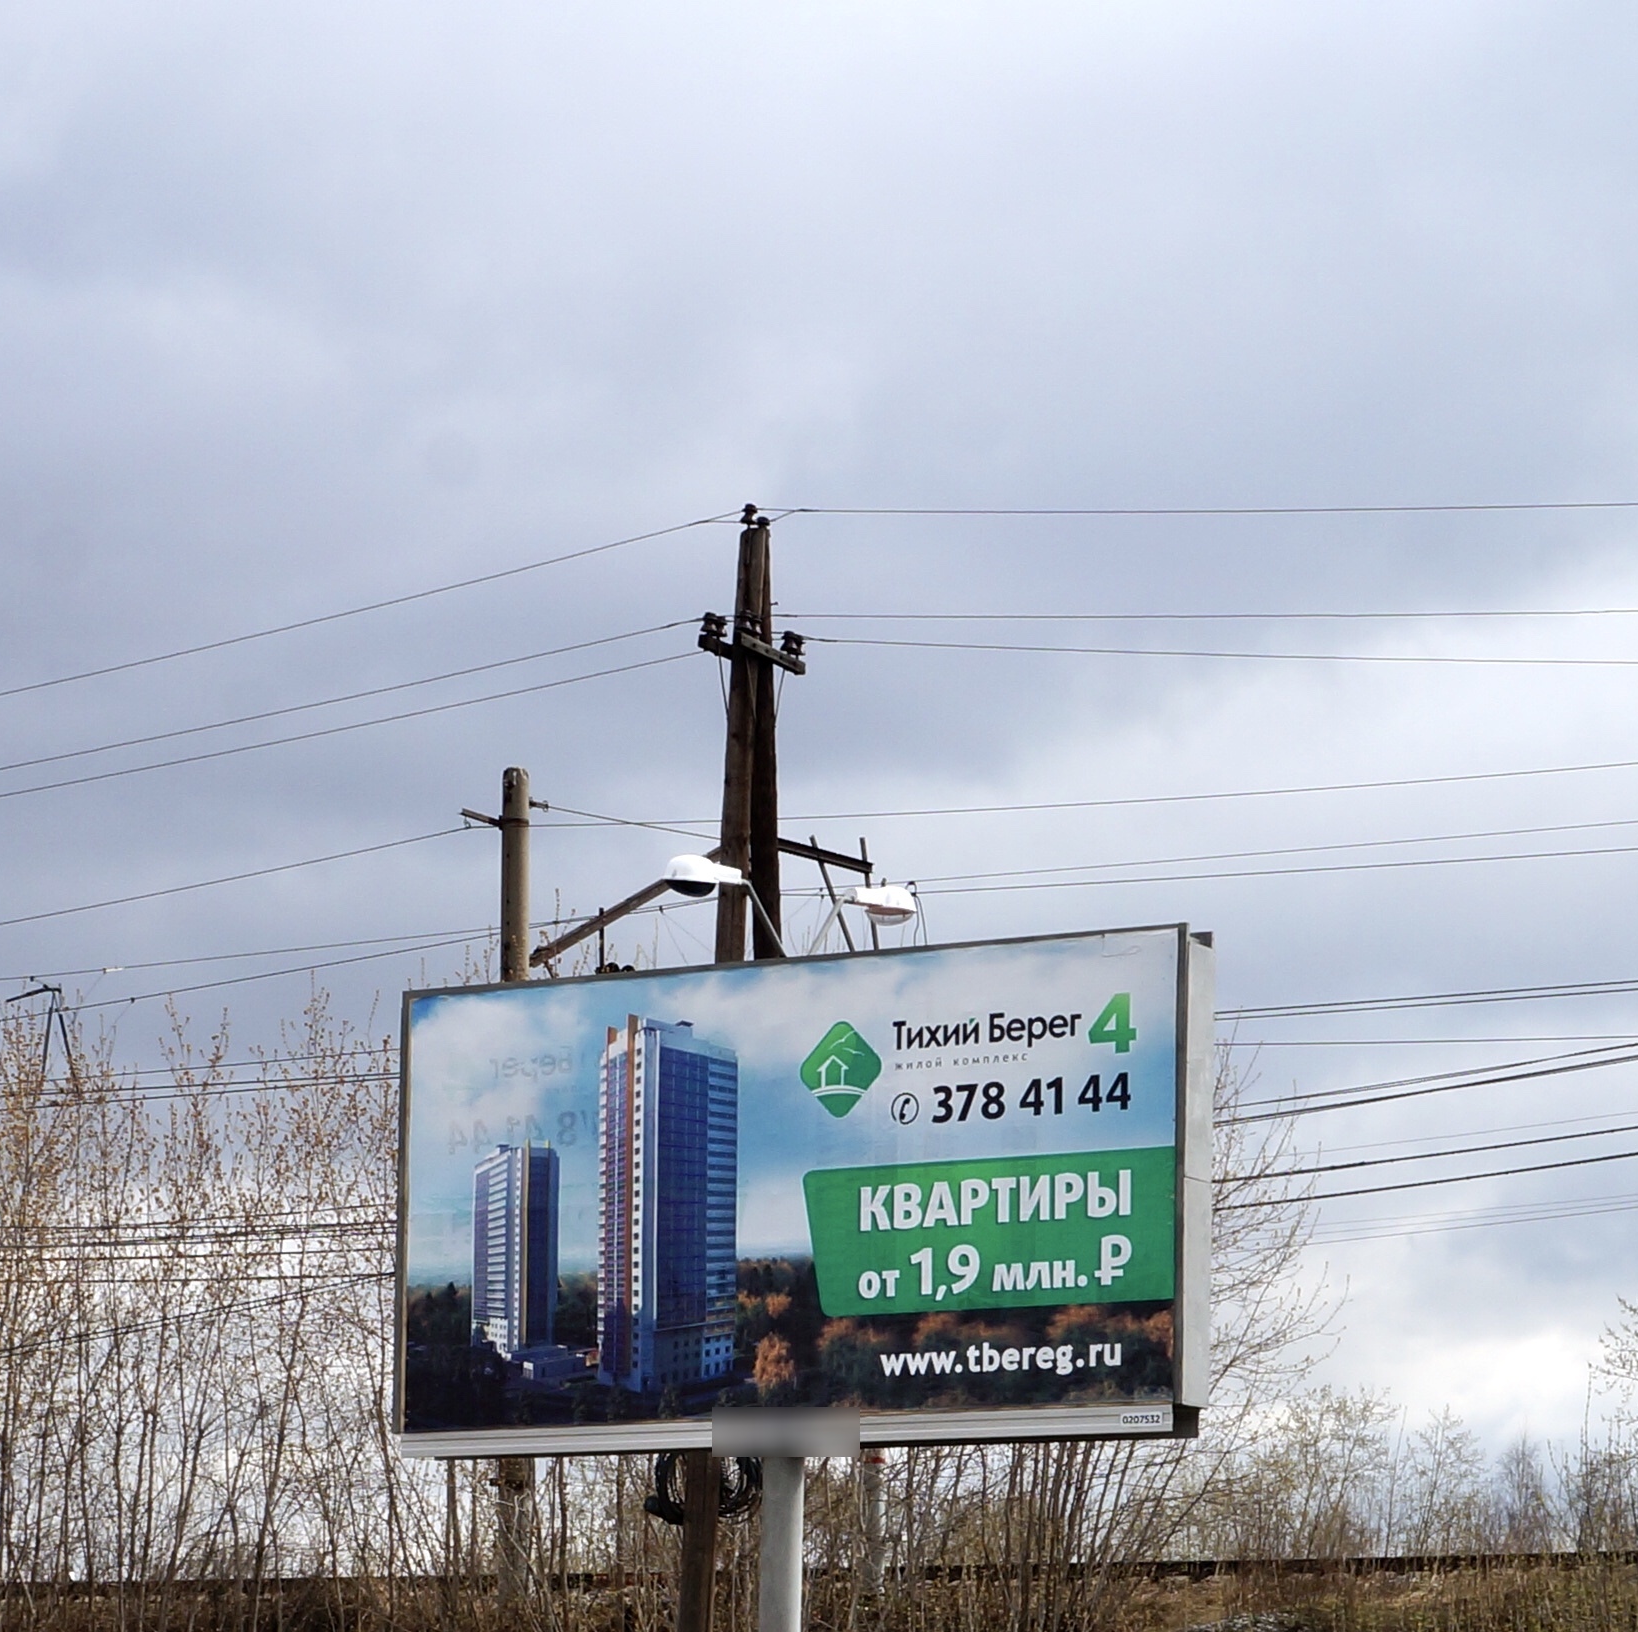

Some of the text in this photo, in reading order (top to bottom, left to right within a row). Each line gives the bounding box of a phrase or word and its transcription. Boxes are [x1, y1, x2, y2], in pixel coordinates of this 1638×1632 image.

[893, 992, 1137, 1054] Тихий Берег 4
[894, 1052, 1029, 1071] жилой комплекс
[931, 1072, 1131, 1124] 378 41 44
[859, 1169, 1132, 1232] КВАРТИРЫ
[858, 1269, 900, 1299] от
[909, 1244, 981, 1301] 1,9
[992, 1259, 1088, 1292] млн.
[880, 1342, 1122, 1376] www.tbereg.ru
[1122, 1414, 1161, 1424] 0207532
